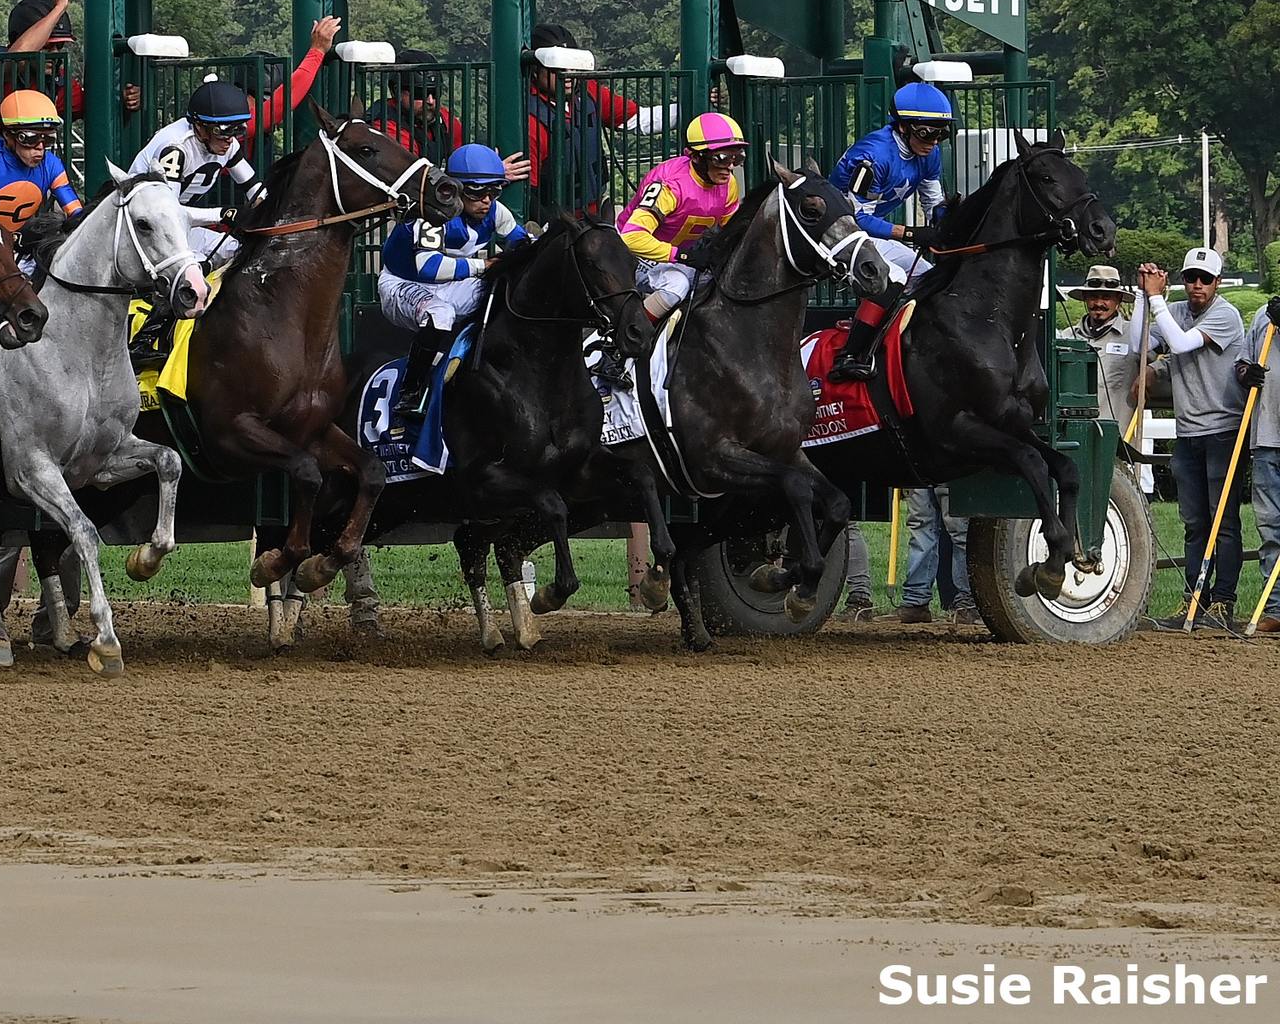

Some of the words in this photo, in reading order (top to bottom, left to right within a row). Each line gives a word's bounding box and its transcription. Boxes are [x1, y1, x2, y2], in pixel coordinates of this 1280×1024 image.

[160, 149, 181, 179] 4
[852, 166, 867, 193] 1
[639, 182, 662, 208] 2
[421, 221, 443, 249] 3
[363, 368, 399, 443] 3
